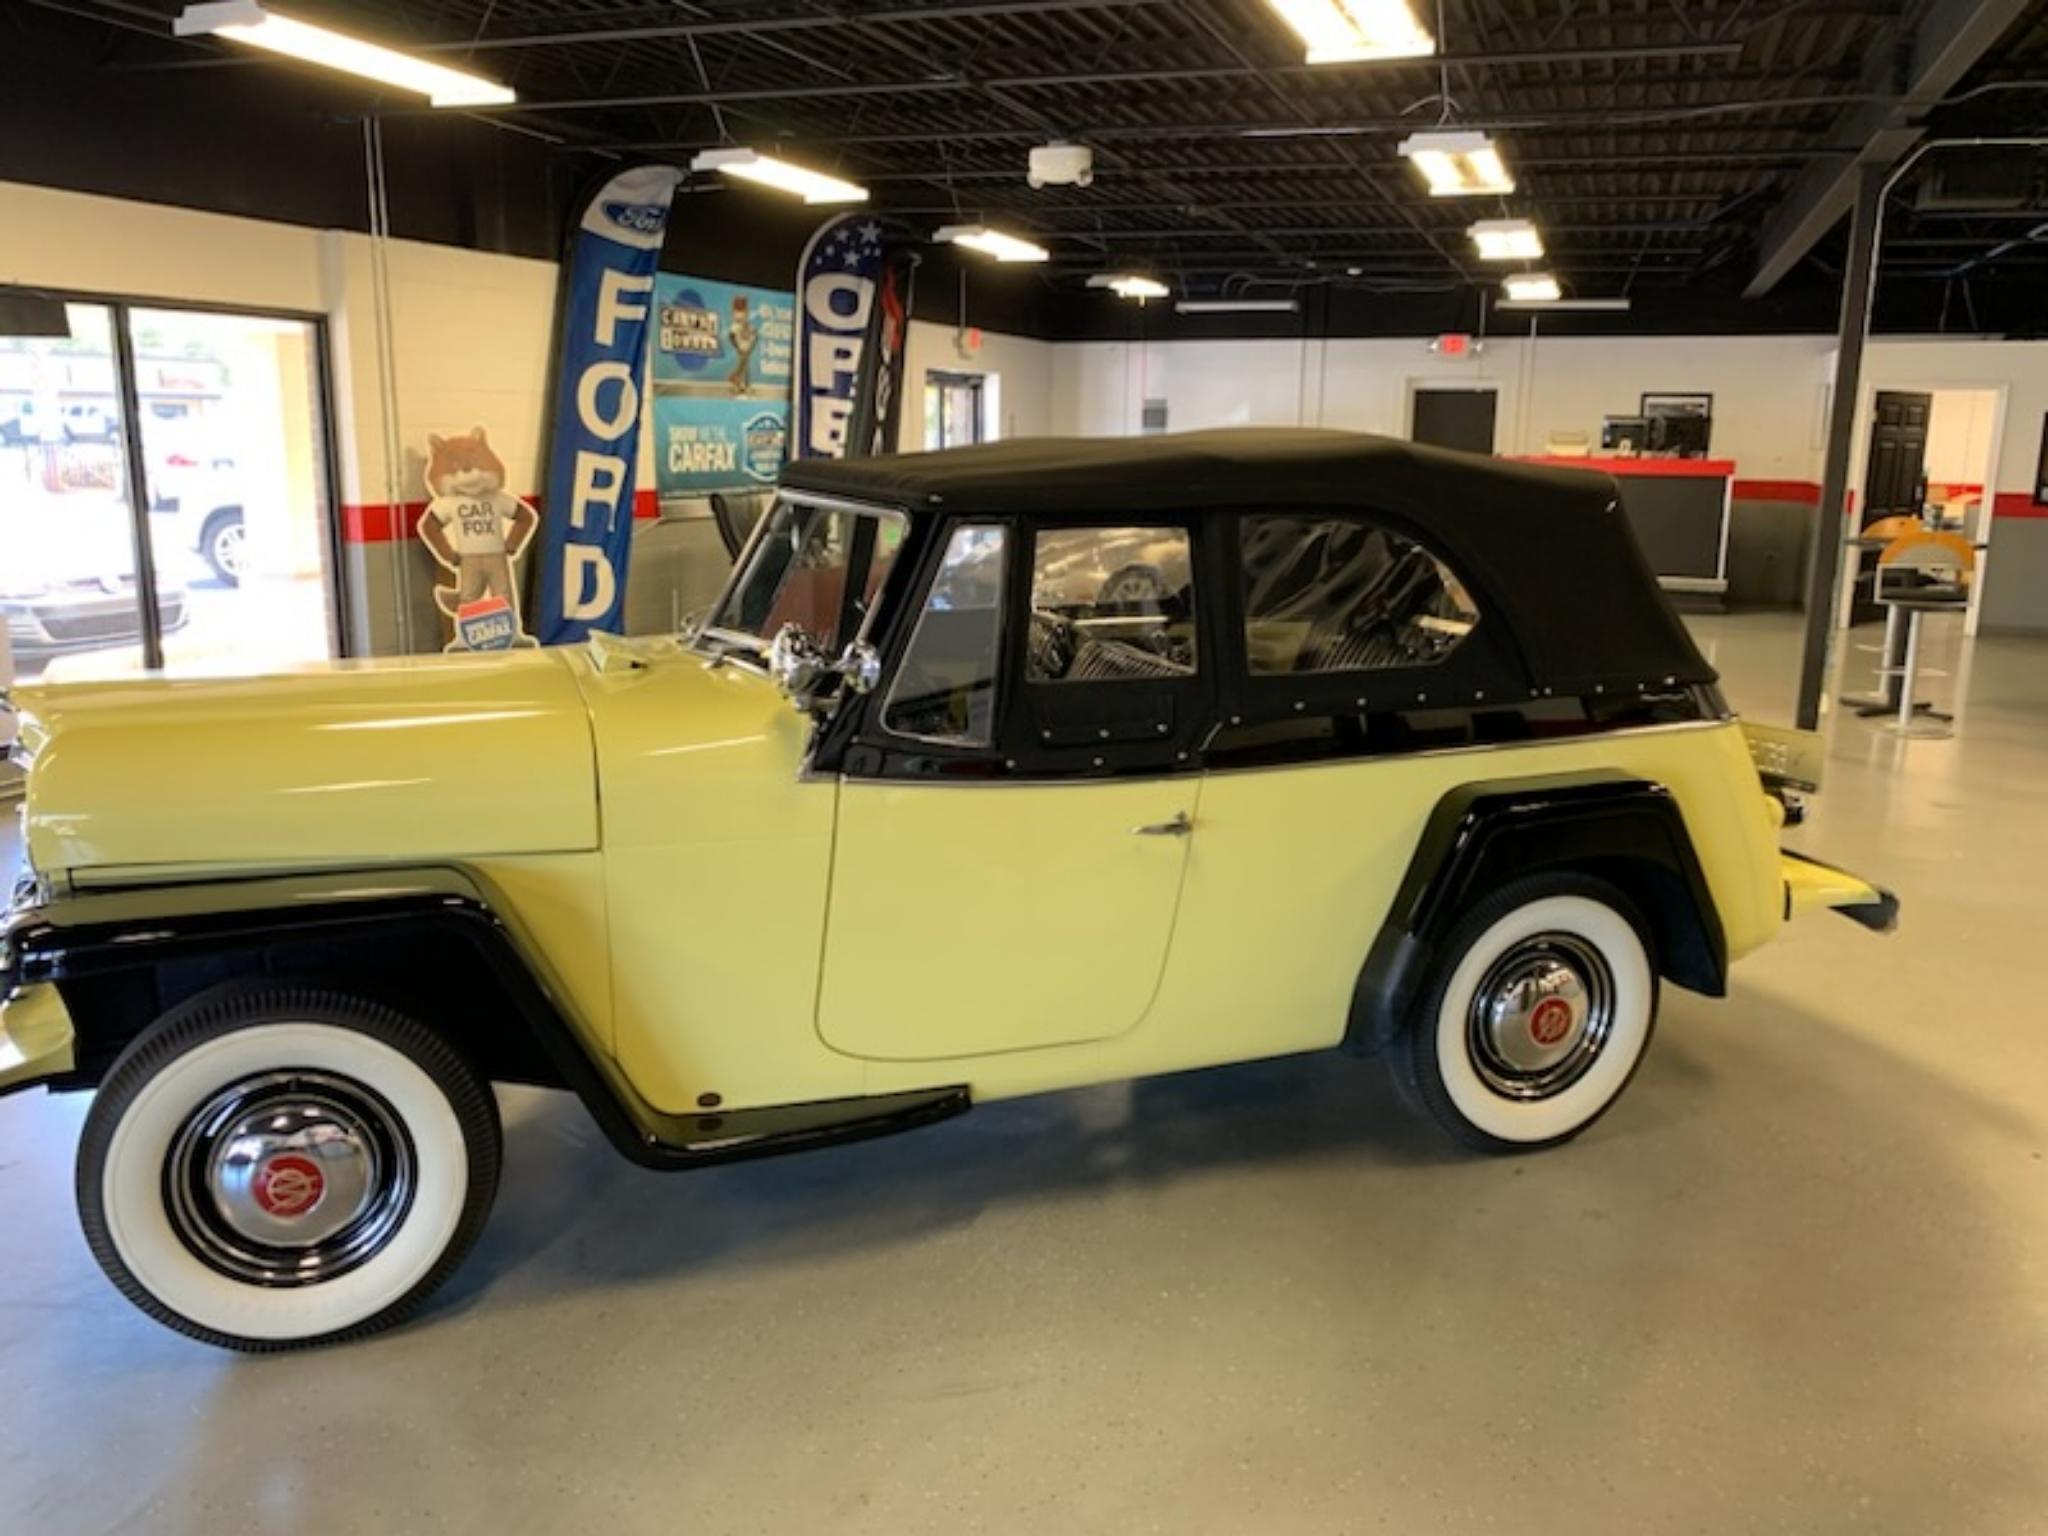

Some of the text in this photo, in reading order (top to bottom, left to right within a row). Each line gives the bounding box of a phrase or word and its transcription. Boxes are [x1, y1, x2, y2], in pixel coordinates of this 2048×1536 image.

[805, 272, 876, 459] OPE
[562, 268, 654, 621] FORD
[668, 442, 738, 473] CARFAX
[457, 502, 495, 519] CAR
[463, 519, 496, 536] FOX
